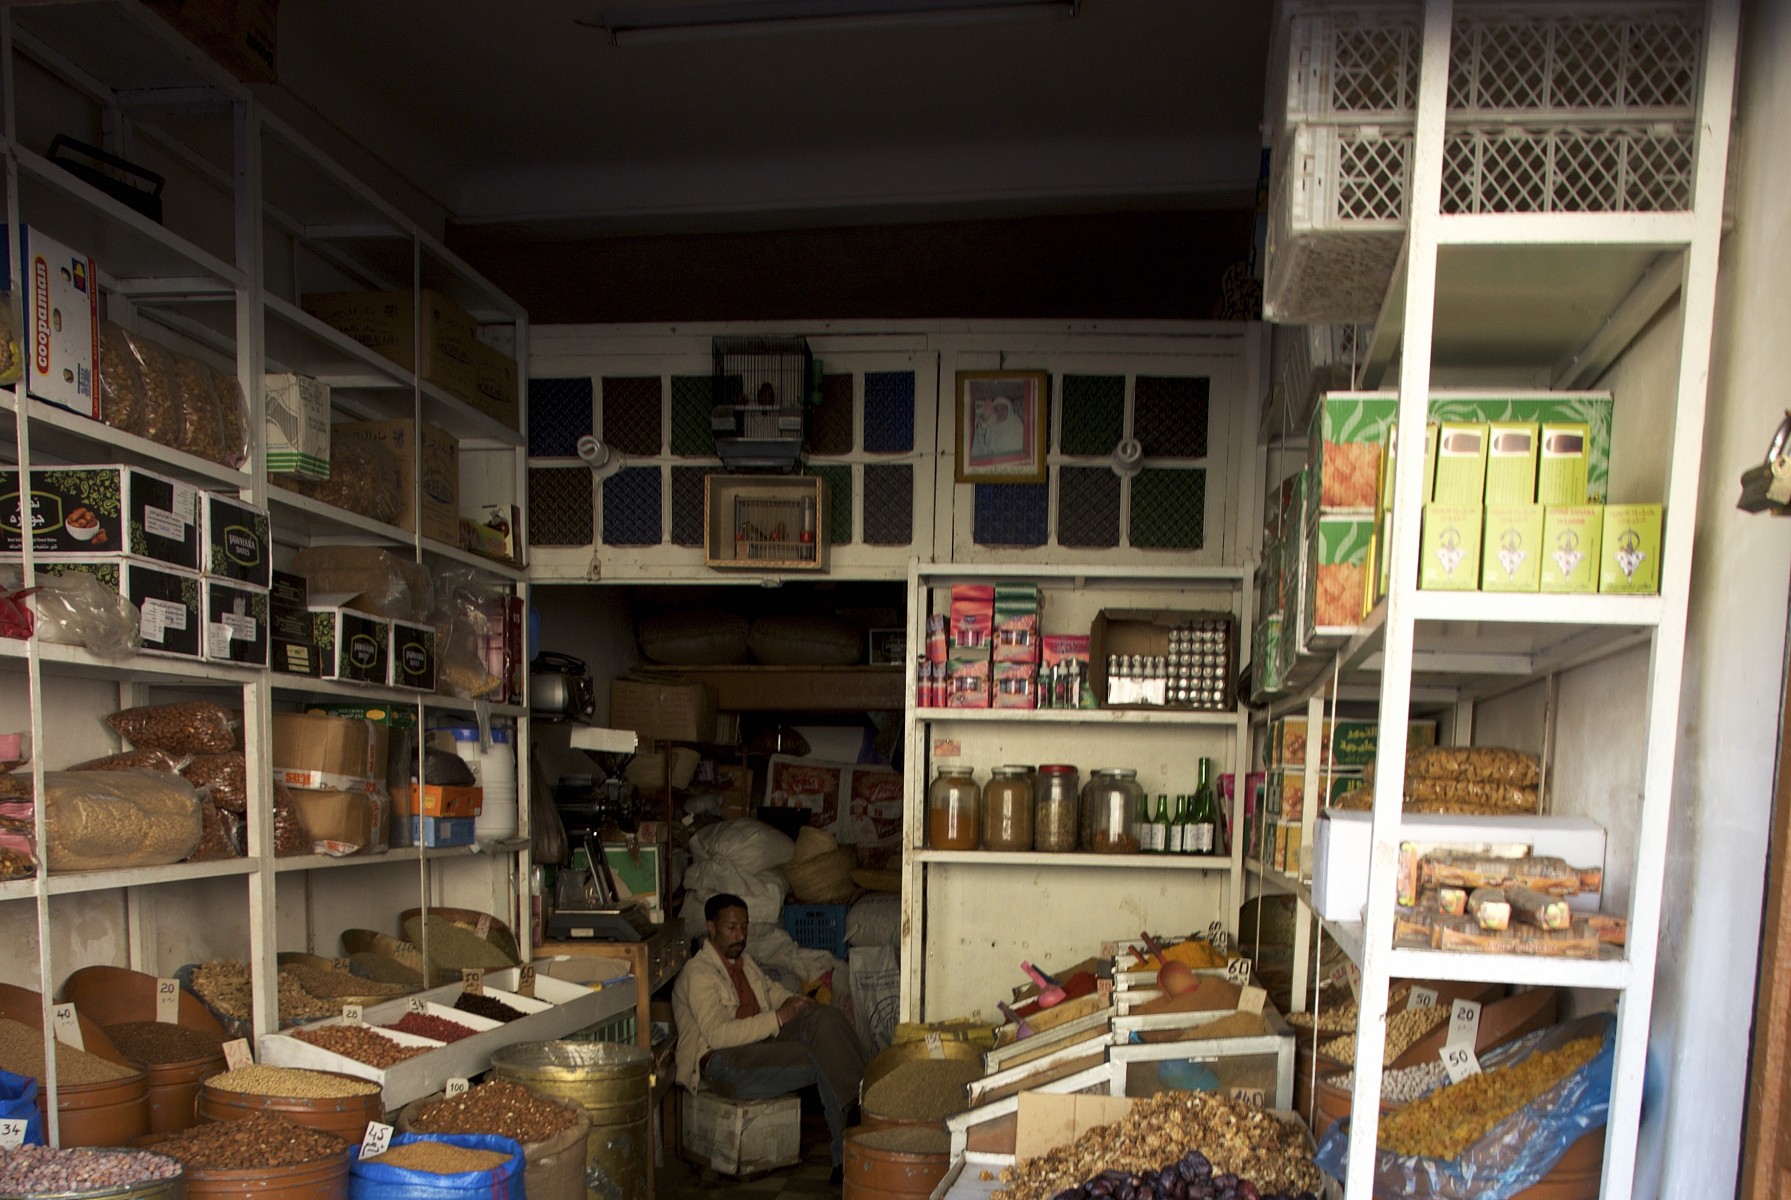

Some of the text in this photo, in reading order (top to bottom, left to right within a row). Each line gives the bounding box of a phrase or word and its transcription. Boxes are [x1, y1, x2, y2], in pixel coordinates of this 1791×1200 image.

[36, 261, 50, 368] coopaman
[1228, 959, 1249, 975] 60
[465, 973, 479, 982] 50
[160, 983, 174, 994] 20
[1415, 993, 1431, 1007] 50
[57, 1009, 71, 1019] 40
[346, 1009, 358, 1019] 28
[1457, 1007, 1474, 1022] 20
[1449, 1049, 1468, 1066] 50
[450, 1083, 464, 1092] 100
[2, 1123, 21, 1135] 34
[369, 1125, 388, 1140] 45
